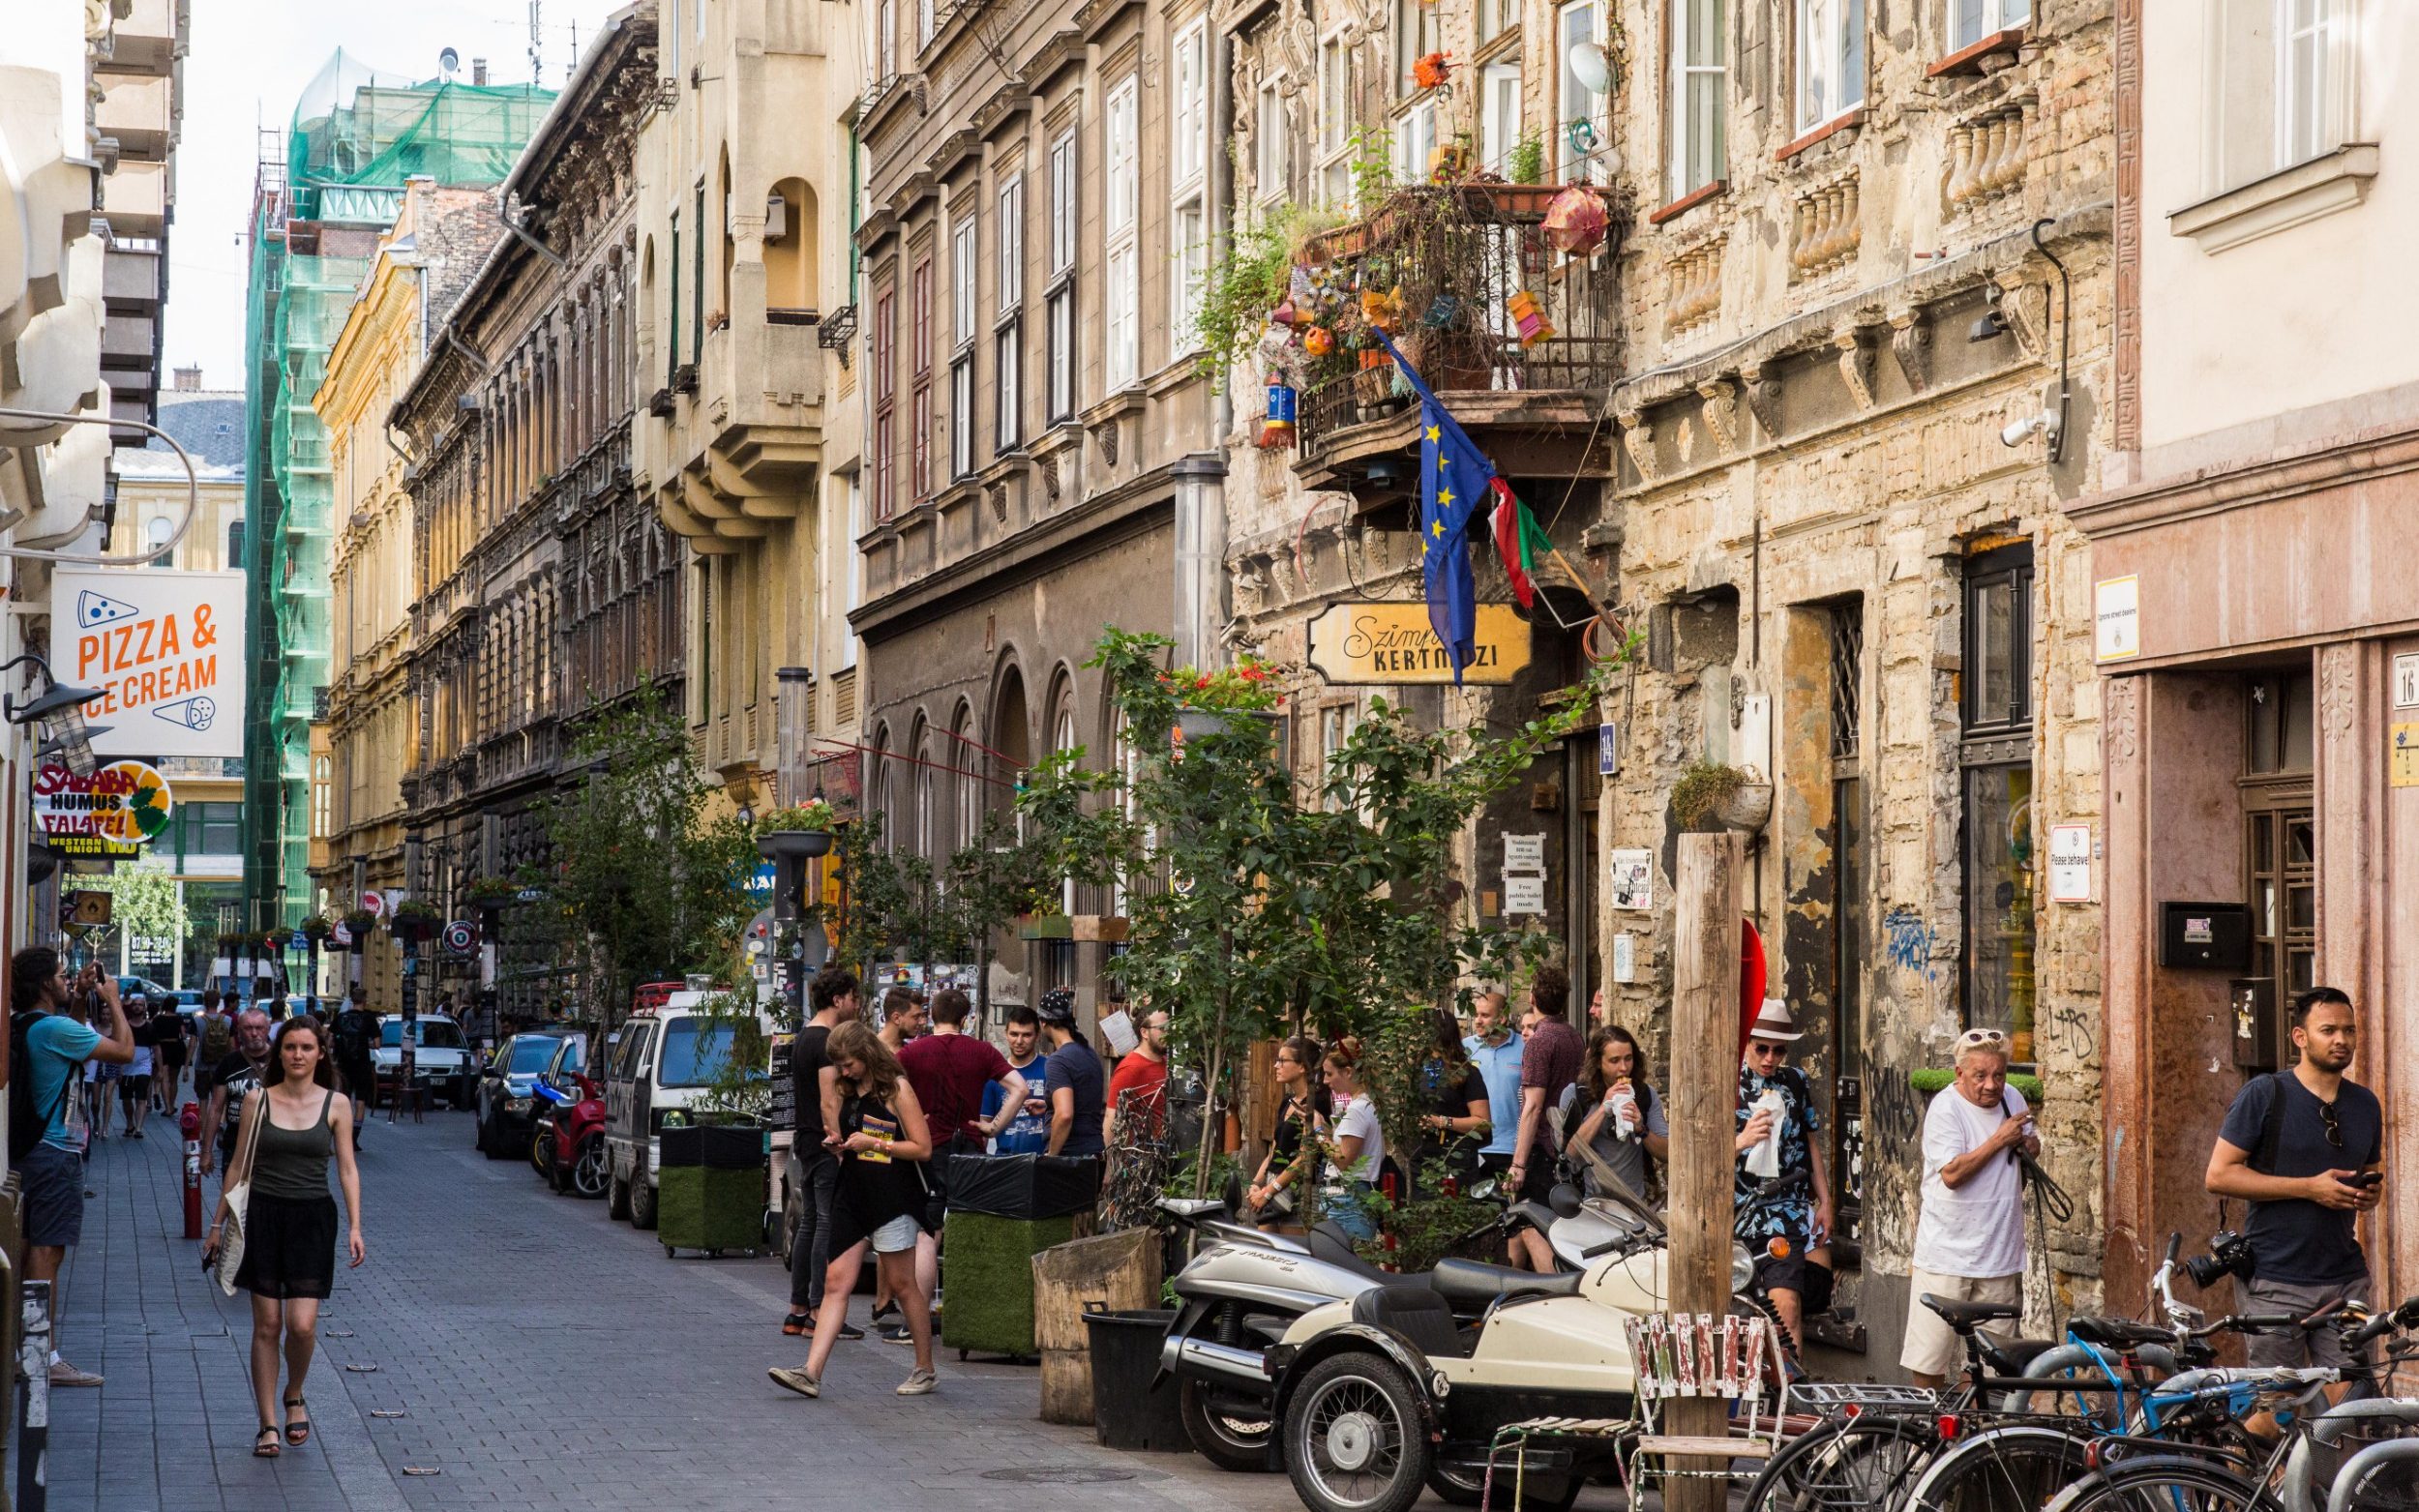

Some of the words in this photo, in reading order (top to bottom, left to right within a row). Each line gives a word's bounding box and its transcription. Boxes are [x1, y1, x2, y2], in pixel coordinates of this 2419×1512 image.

[78, 613, 180, 681] PIZZA
[192, 604, 217, 649] &
[1344, 615, 1442, 663] Szimp
[1374, 644, 1498, 671] KERTMZI
[123, 654, 217, 709] CREAM
[2403, 669, 2414, 702] 16
[50, 793, 122, 811] HUMUS
[42, 815, 127, 835] FALAFEL
[2051, 853, 2067, 866] Please
[2068, 852, 2090, 866] behave!
